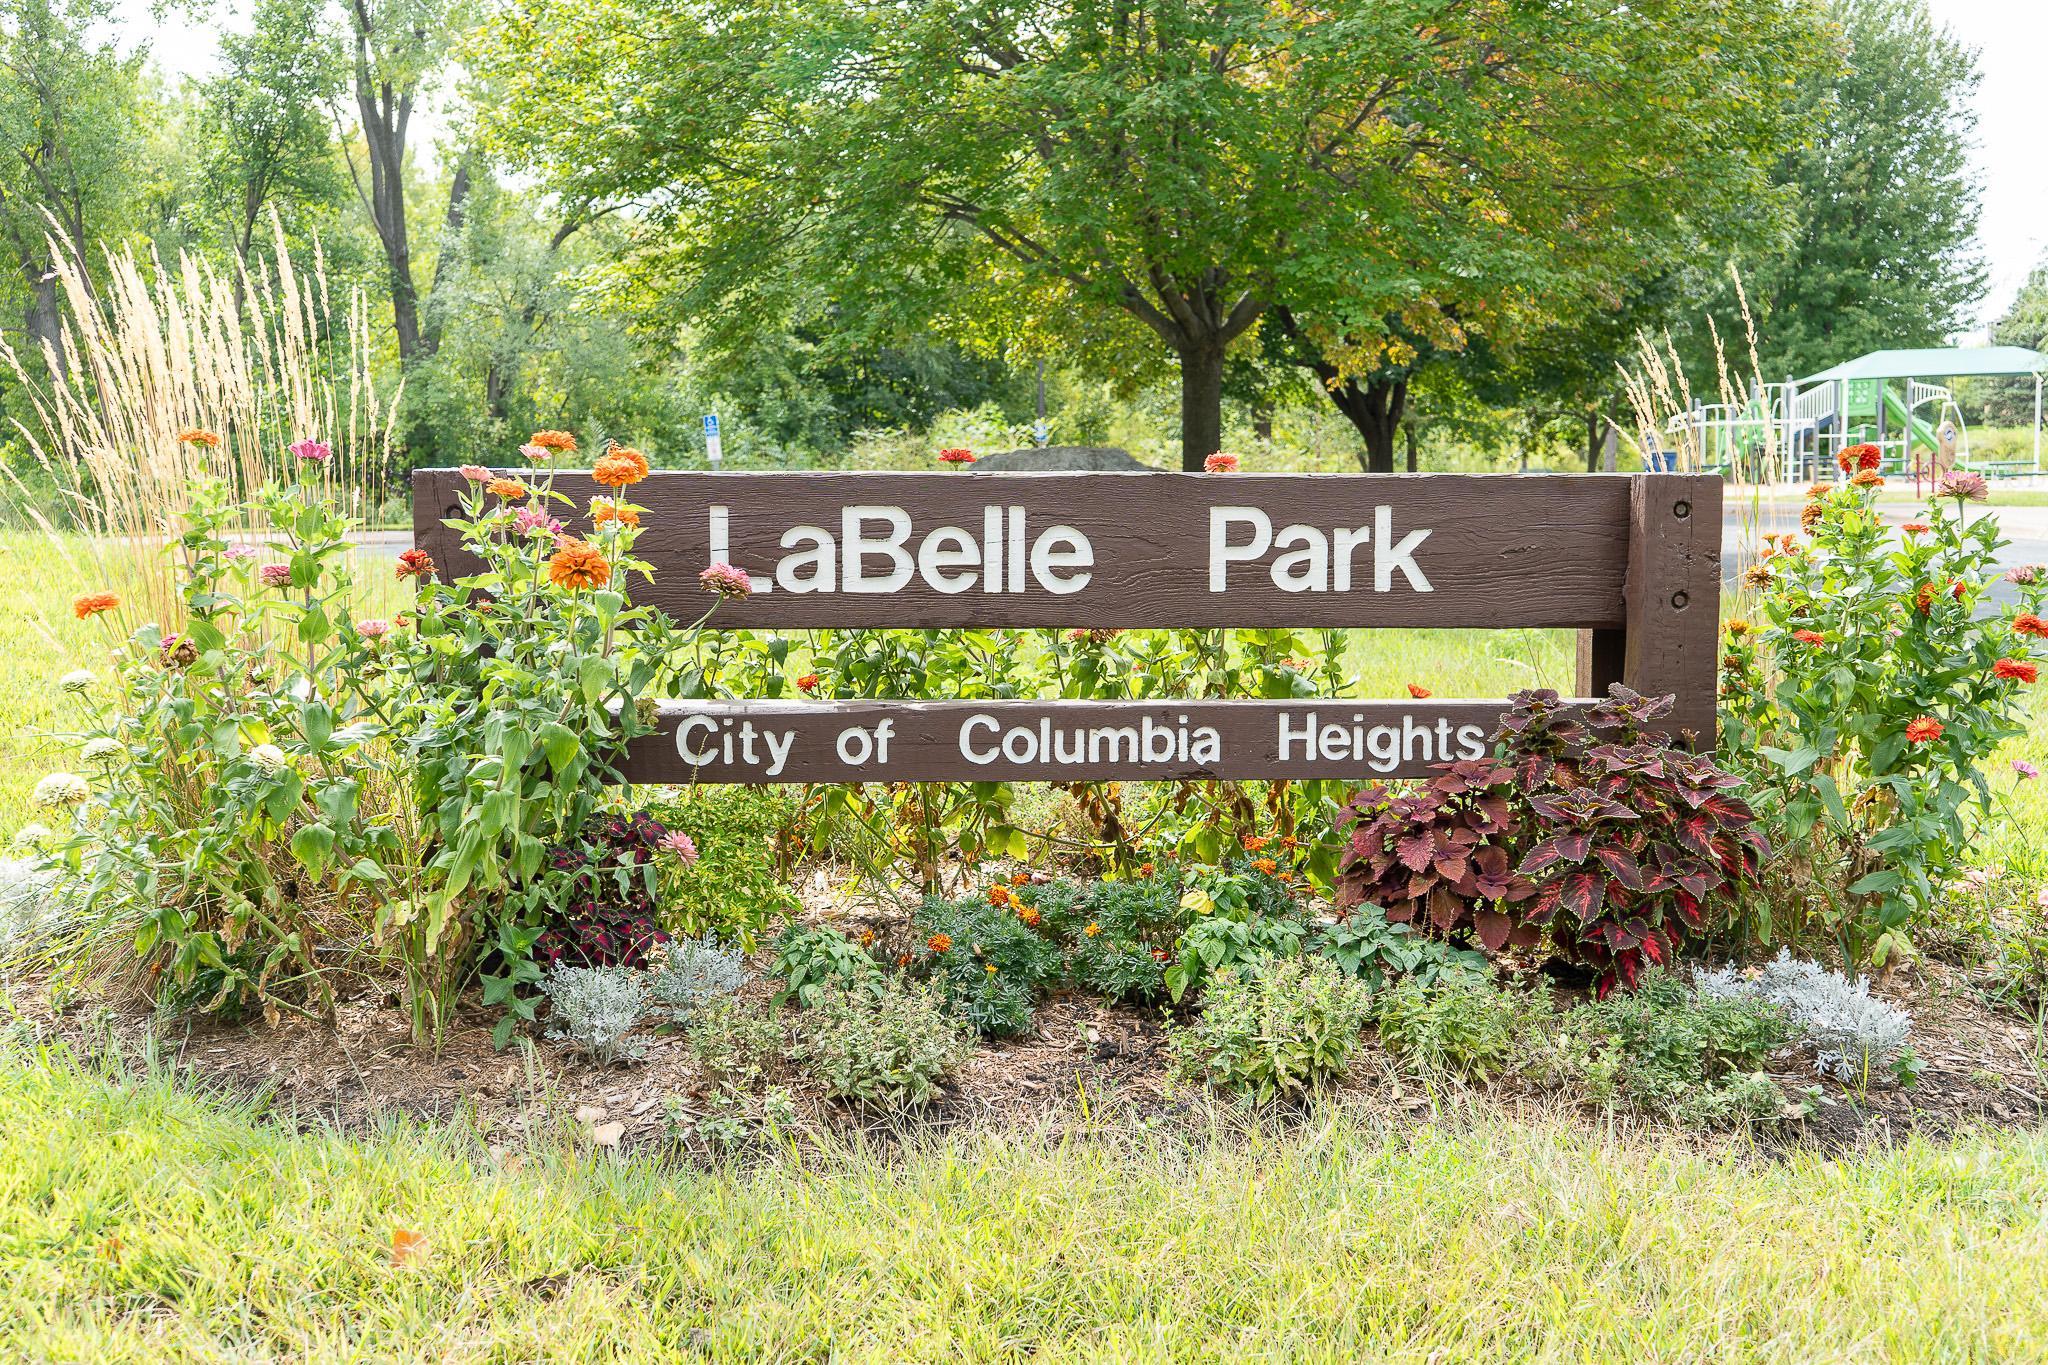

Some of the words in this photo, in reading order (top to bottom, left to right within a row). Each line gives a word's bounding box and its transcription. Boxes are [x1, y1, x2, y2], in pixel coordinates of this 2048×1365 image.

[709, 505, 1095, 595] LaBelle
[1209, 504, 1435, 593] Park
[675, 714, 796, 776] City
[836, 716, 896, 766] of
[958, 713, 1221, 765] Columbia
[1278, 711, 1487, 774] Heights
